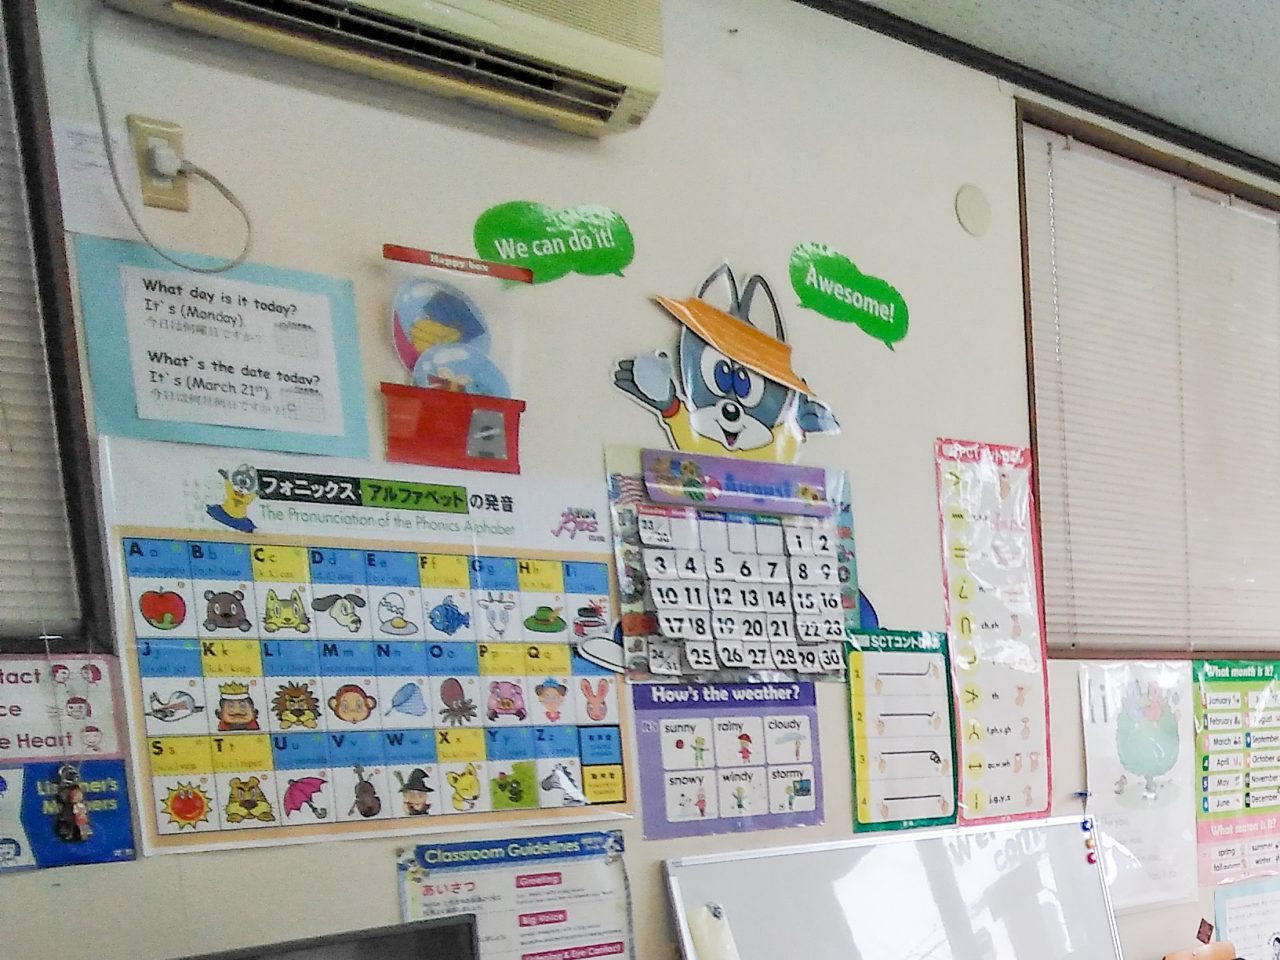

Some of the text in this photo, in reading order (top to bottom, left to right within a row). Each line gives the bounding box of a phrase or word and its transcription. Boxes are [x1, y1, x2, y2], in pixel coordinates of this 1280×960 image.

[494, 228, 616, 260] We can do it!
[430, 253, 465, 270] Happy
[142, 278, 298, 317] What day is it today?
[805, 262, 895, 323] Awesome!
[211, 359, 235, 375] the
[241, 365, 271, 380] date
[276, 370, 321, 386] today?
[186, 376, 236, 395] (March
[725, 473, 794, 504] August
[259, 504, 514, 537] The Pronunciation of the Phonics Alphabet
[129, 542, 144, 557] A
[795, 535, 829, 551] 1 2
[191, 545, 204, 559] B
[254, 548, 266, 563] C
[311, 551, 324, 565] D
[367, 553, 376, 567] E
[419, 556, 428, 569] F
[471, 560, 482, 573] G
[519, 561, 530, 575] H
[654, 556, 831, 580] 3 4 5 6 7 8 9
[657, 587, 838, 609] 10 11 12 13 14 15 16
[665, 617, 842, 637] 17 18 19 20 21 22 23
[141, 642, 151, 656] J
[202, 642, 217, 657] K
[263, 643, 274, 657] L
[322, 644, 339, 657] M
[377, 644, 390, 657] N
[429, 645, 443, 658] O
[479, 645, 488, 657] P
[528, 646, 540, 659] Q
[691, 647, 839, 666] 25 26 27 28 29 30
[1208, 666, 1229, 677] What
[1231, 666, 1256, 677] month
[1257, 666, 1263, 676] is
[652, 684, 800, 703] How's the weather?
[1209, 697, 1231, 705] January
[665, 724, 696, 735] sunny
[717, 720, 743, 732] rainy
[768, 719, 802, 731] cloudy
[1209, 717, 1233, 726] February
[17, 733, 72, 749] Heart
[332, 735, 345, 748] V
[386, 733, 404, 746] W
[438, 732, 450, 744] X
[488, 730, 498, 743] Y
[536, 729, 545, 741] Z
[1253, 736, 1279, 744] September
[152, 741, 164, 755] S
[213, 738, 224, 752] T
[274, 737, 287, 750] U
[1217, 758, 1229, 766] April
[669, 769, 804, 787] snowy windy stormy
[1217, 779, 1229, 787] May
[1251, 775, 1278, 783] November
[1216, 799, 1230, 808] June
[1252, 795, 1278, 803] December
[1210, 824, 1233, 837] What
[424, 840, 580, 864] Classroom Guidelines
[1218, 848, 1235, 857] spring
[422, 882, 476, 897] あいさつ
